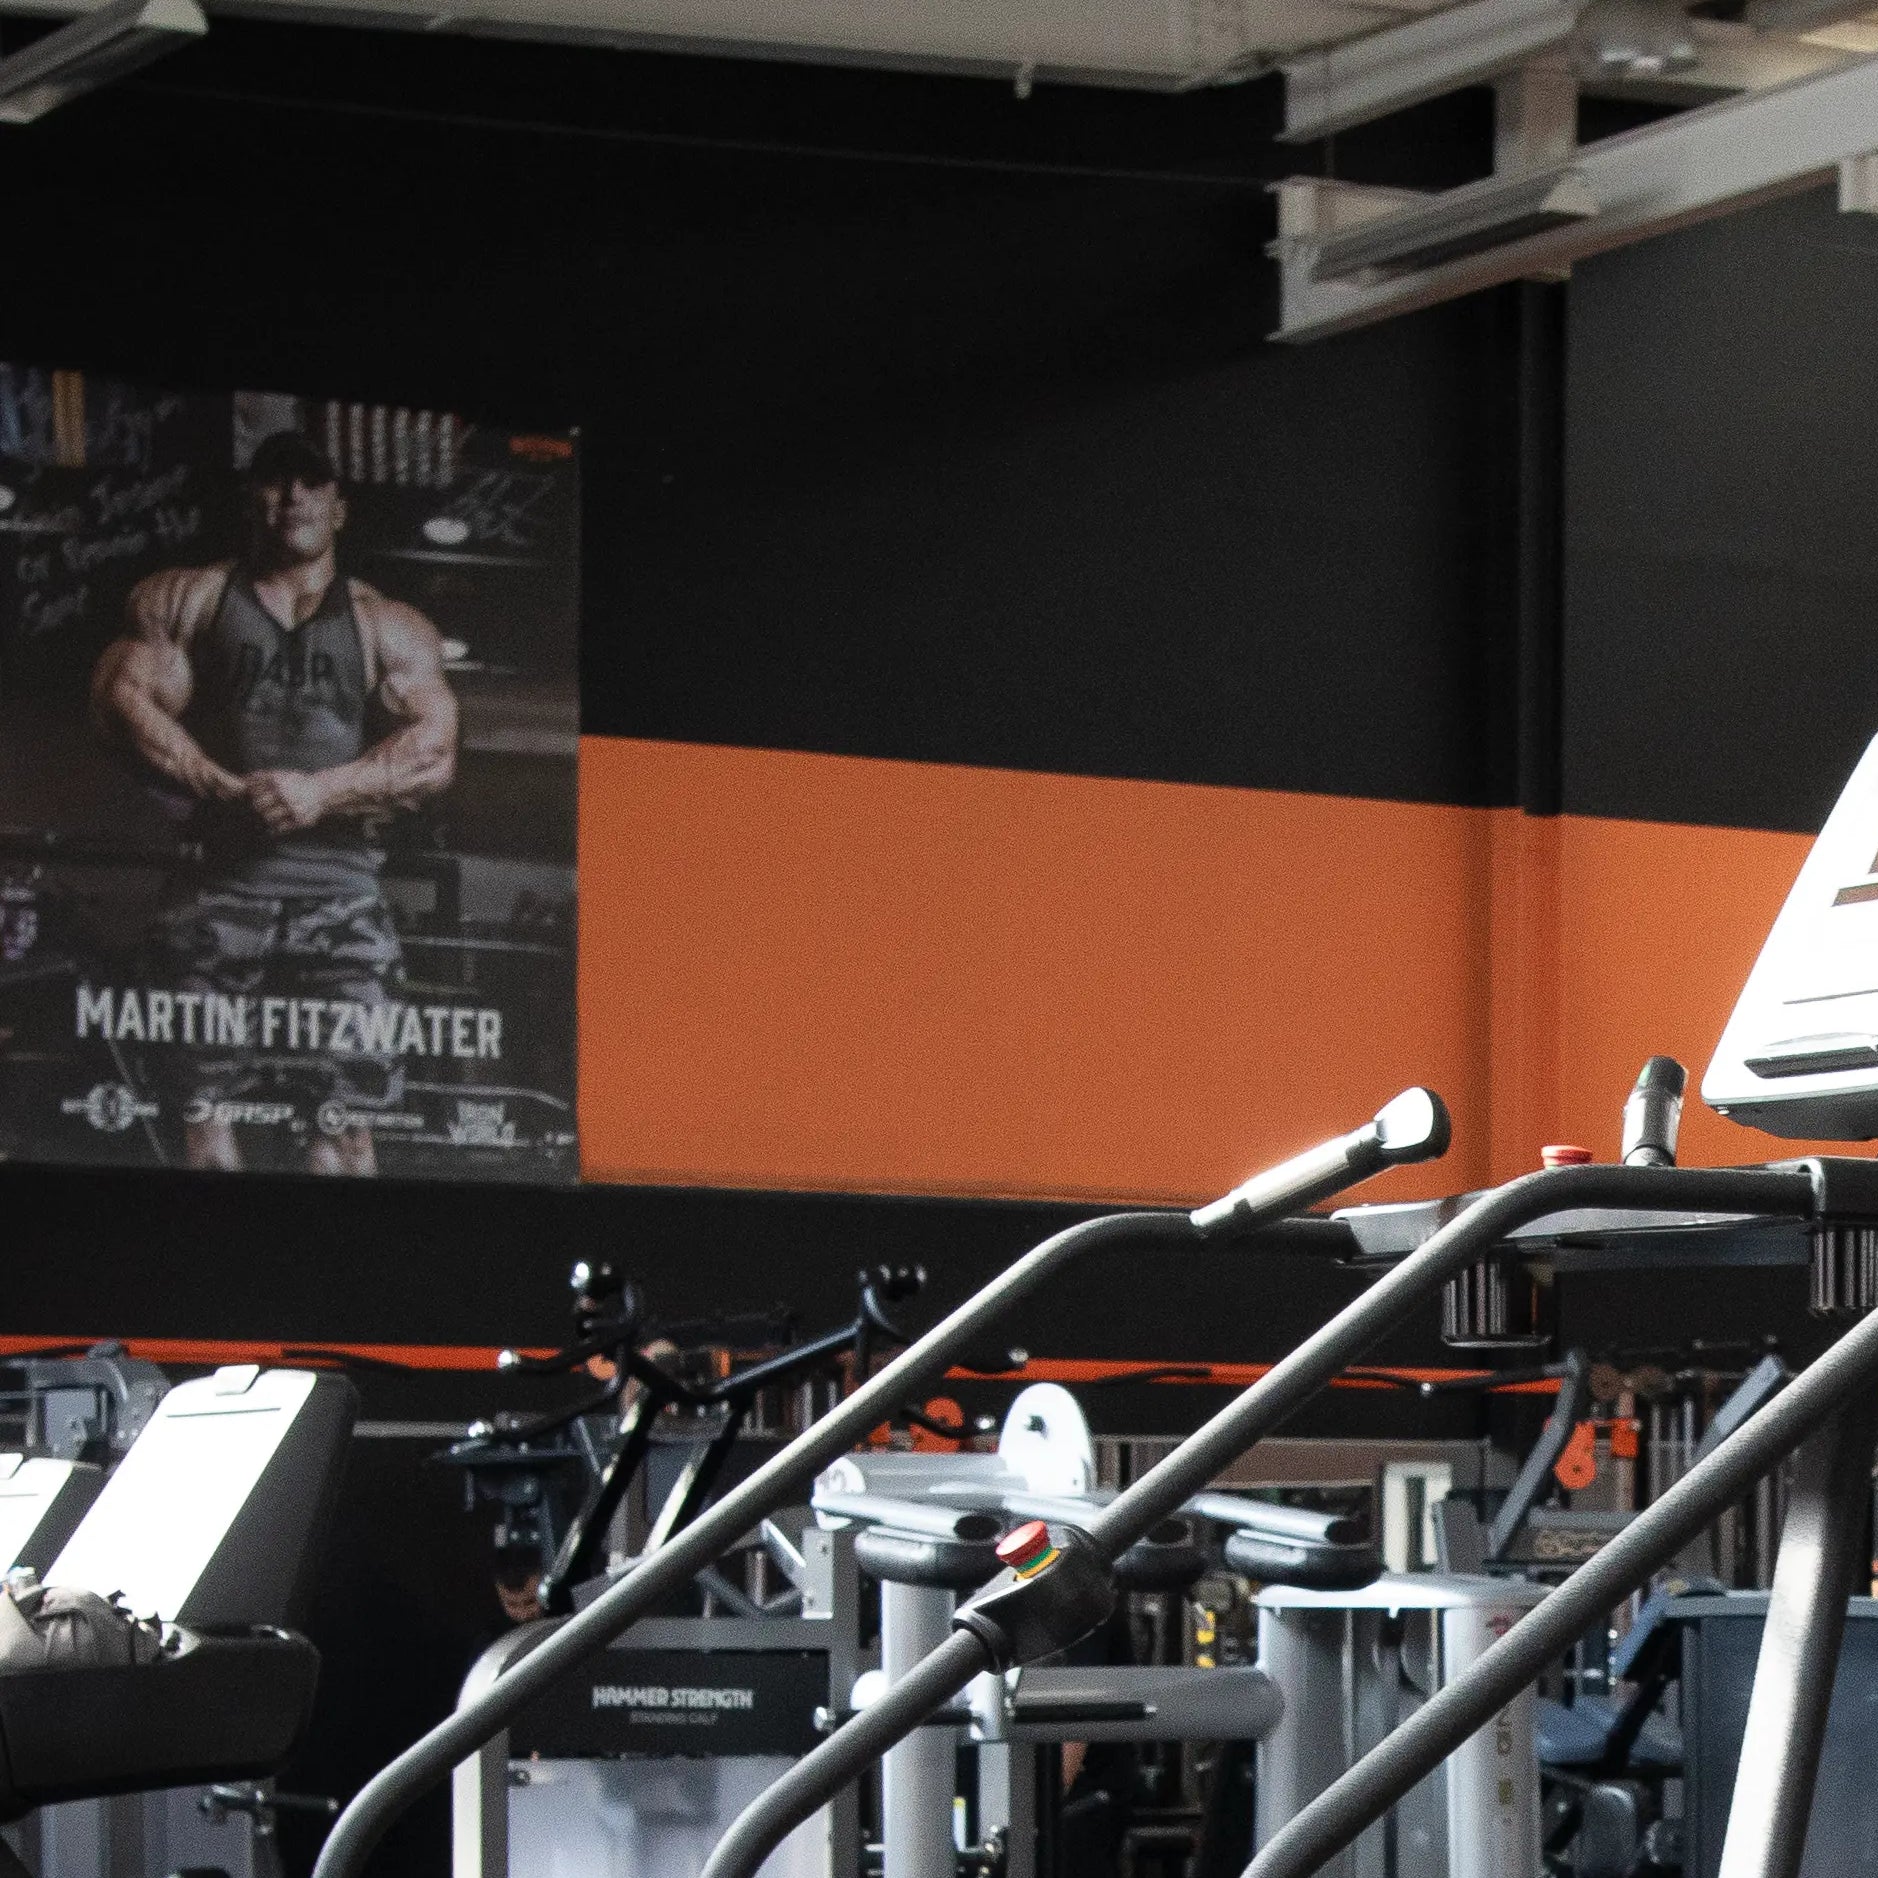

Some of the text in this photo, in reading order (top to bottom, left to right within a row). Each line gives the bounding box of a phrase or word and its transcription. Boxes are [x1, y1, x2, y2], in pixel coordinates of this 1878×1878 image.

[75, 983, 505, 1060] MARTIN FITZWATER
[592, 1685, 754, 1709] HAMMER STRENGTH
